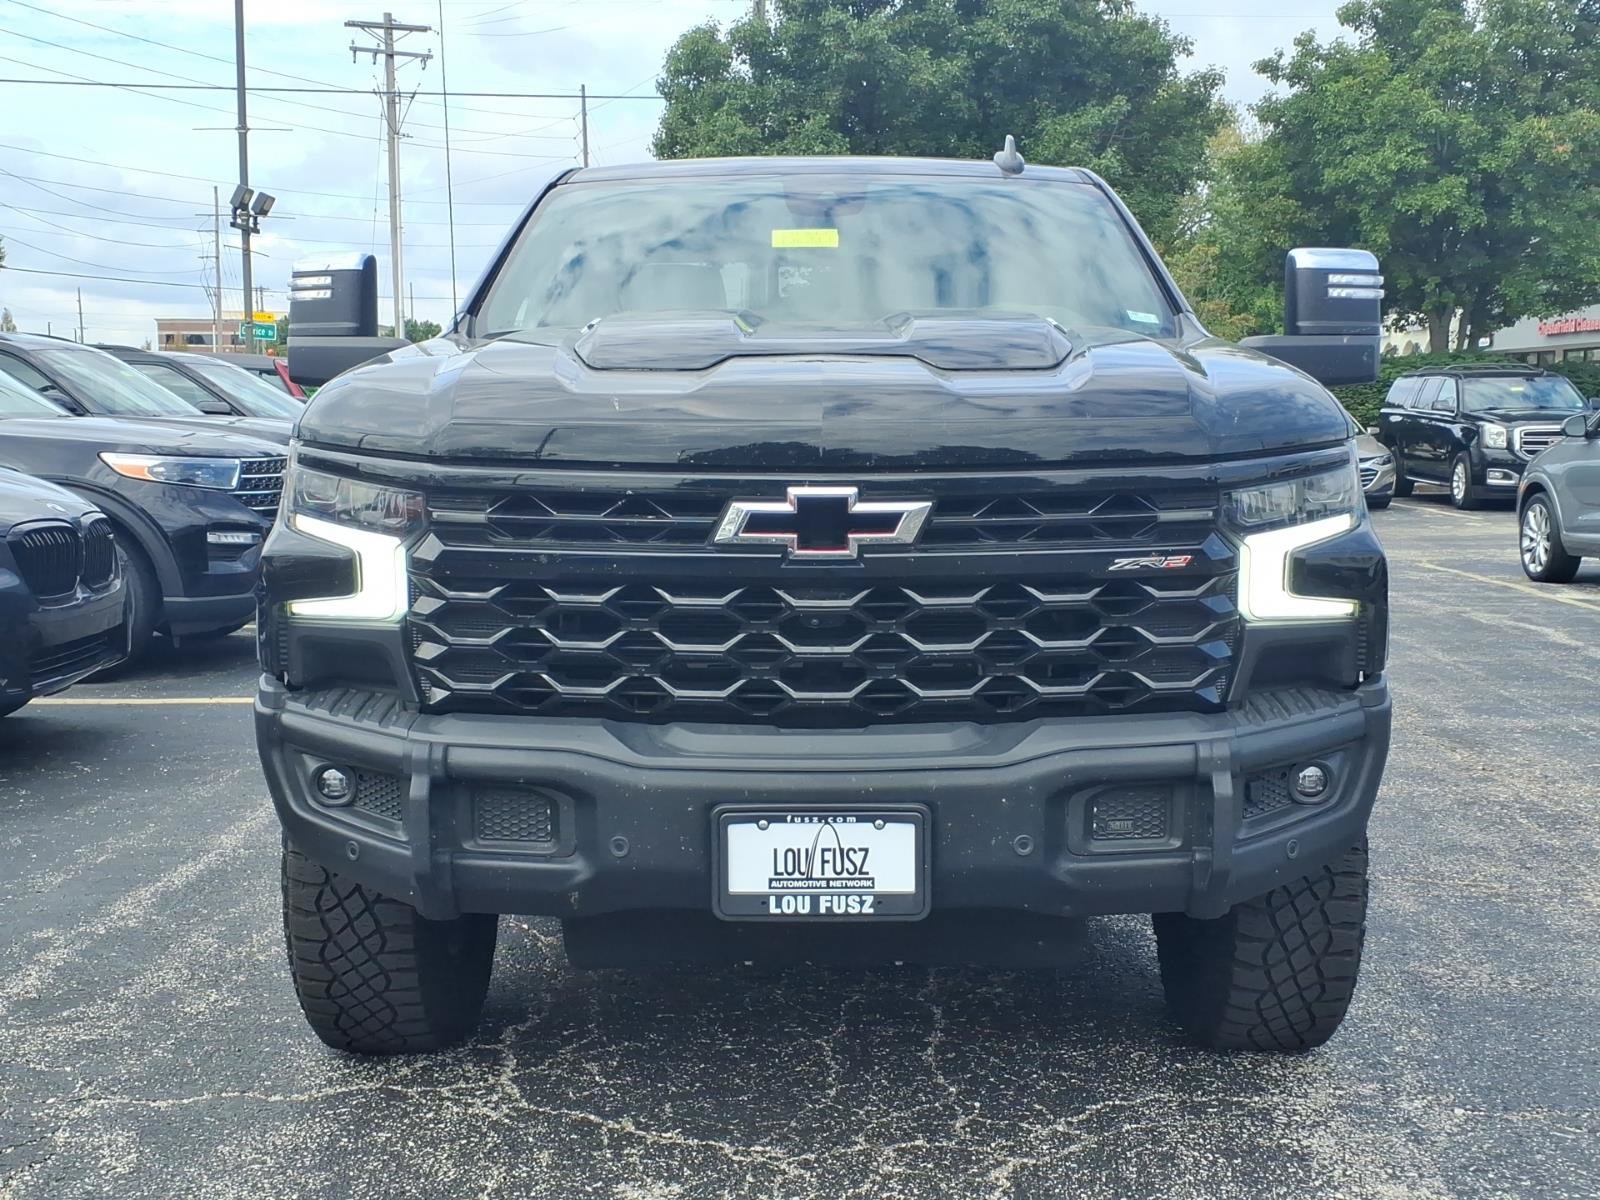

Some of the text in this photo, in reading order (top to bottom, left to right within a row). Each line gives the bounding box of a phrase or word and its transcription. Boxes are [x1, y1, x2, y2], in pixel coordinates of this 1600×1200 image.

[1109, 555, 1193, 571] ZR2
[786, 815, 857, 823] fusz.com
[773, 848, 869, 876] LOU FUSZ
[771, 880, 873, 888] AUTOMOTIVE NETWORK
[769, 896, 875, 914] LOU FUSZ
